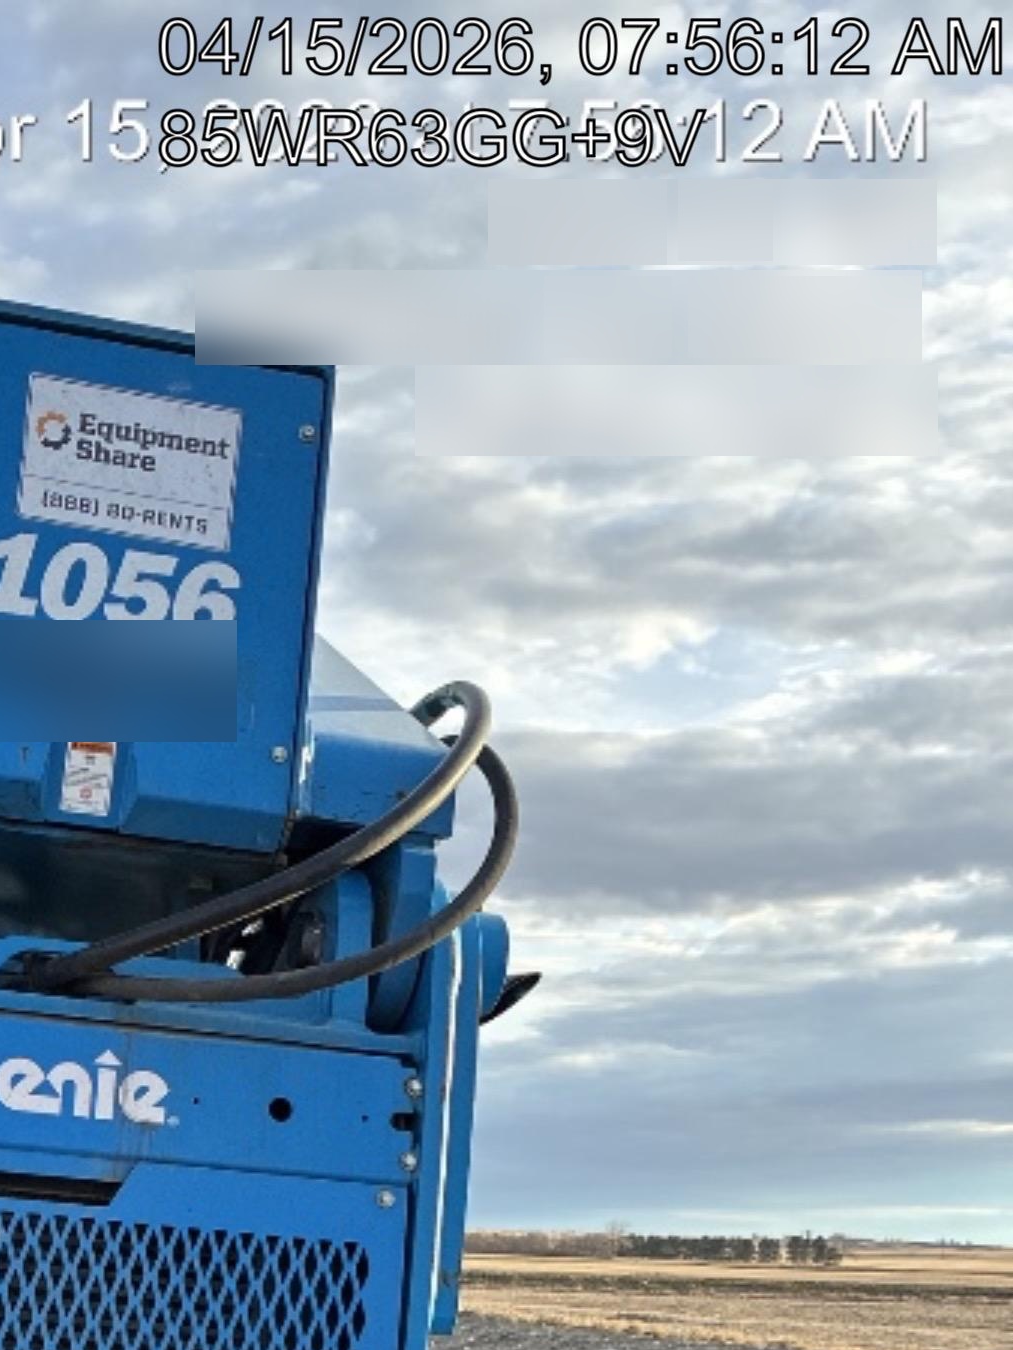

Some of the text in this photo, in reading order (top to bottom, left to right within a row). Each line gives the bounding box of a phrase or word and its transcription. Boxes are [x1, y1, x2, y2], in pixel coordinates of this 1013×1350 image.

[78, 412, 232, 460] Equipment
[75, 437, 157, 473] Share
[41, 490, 100, 517] (888)
